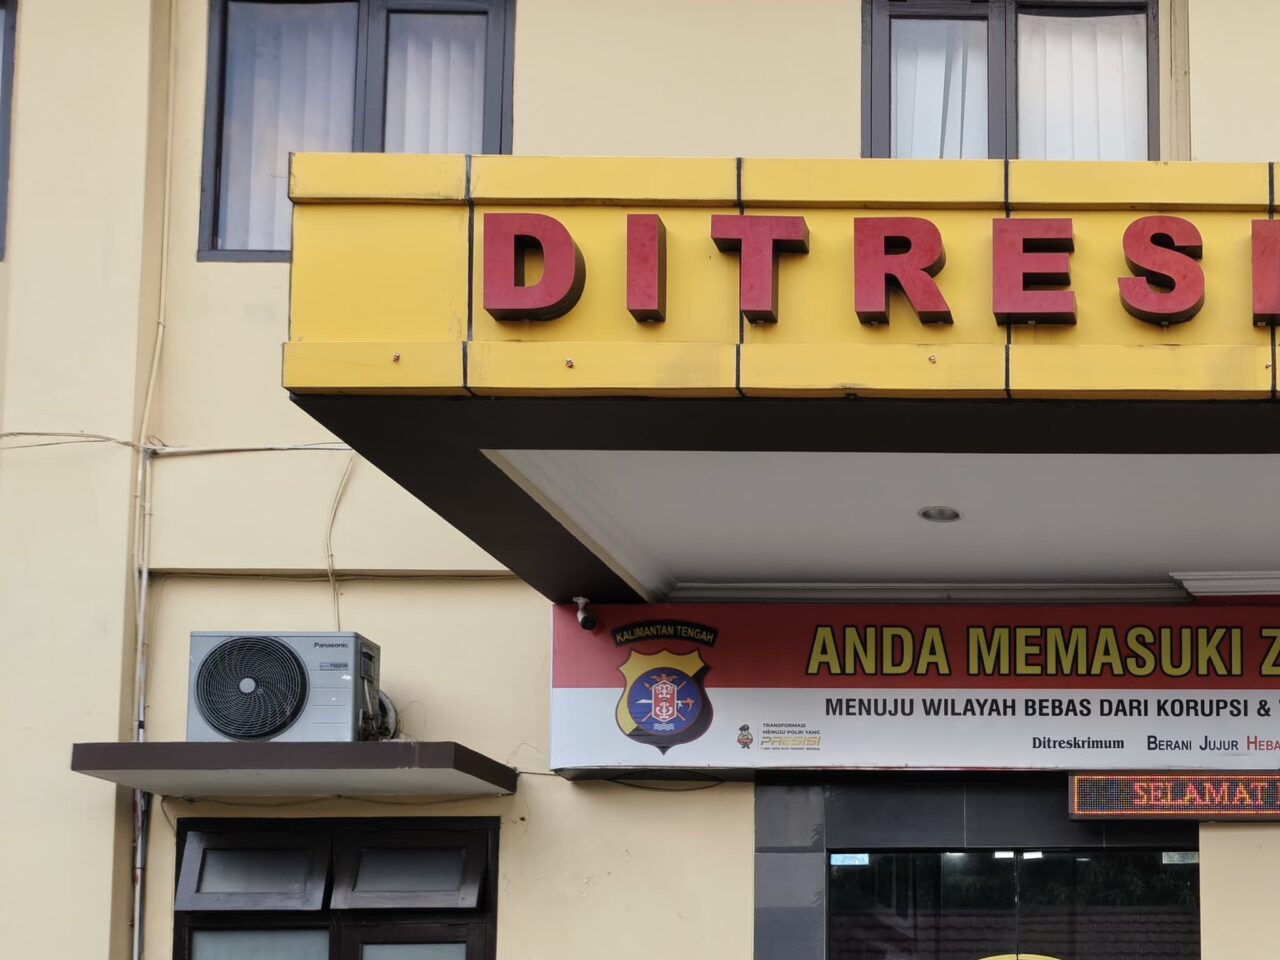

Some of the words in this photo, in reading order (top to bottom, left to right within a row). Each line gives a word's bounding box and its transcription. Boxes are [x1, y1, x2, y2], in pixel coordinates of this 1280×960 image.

[615, 625, 674, 643] KALIMANTAN
[676, 625, 714, 643] TENGAH
[806, 625, 951, 676] ANDA
[967, 624, 1244, 678] MEMASUKI
[825, 698, 914, 717] MENUJU
[922, 698, 1017, 717] WILAYAH
[1024, 698, 1092, 717] BEBAS
[1099, 698, 1149, 717] DARI
[1157, 698, 1249, 717] KORUPSI
[1256, 699, 1271, 717] &
[1032, 736, 1125, 749] Ditreskrimum
[1133, 782, 1268, 806] SELAMAT
